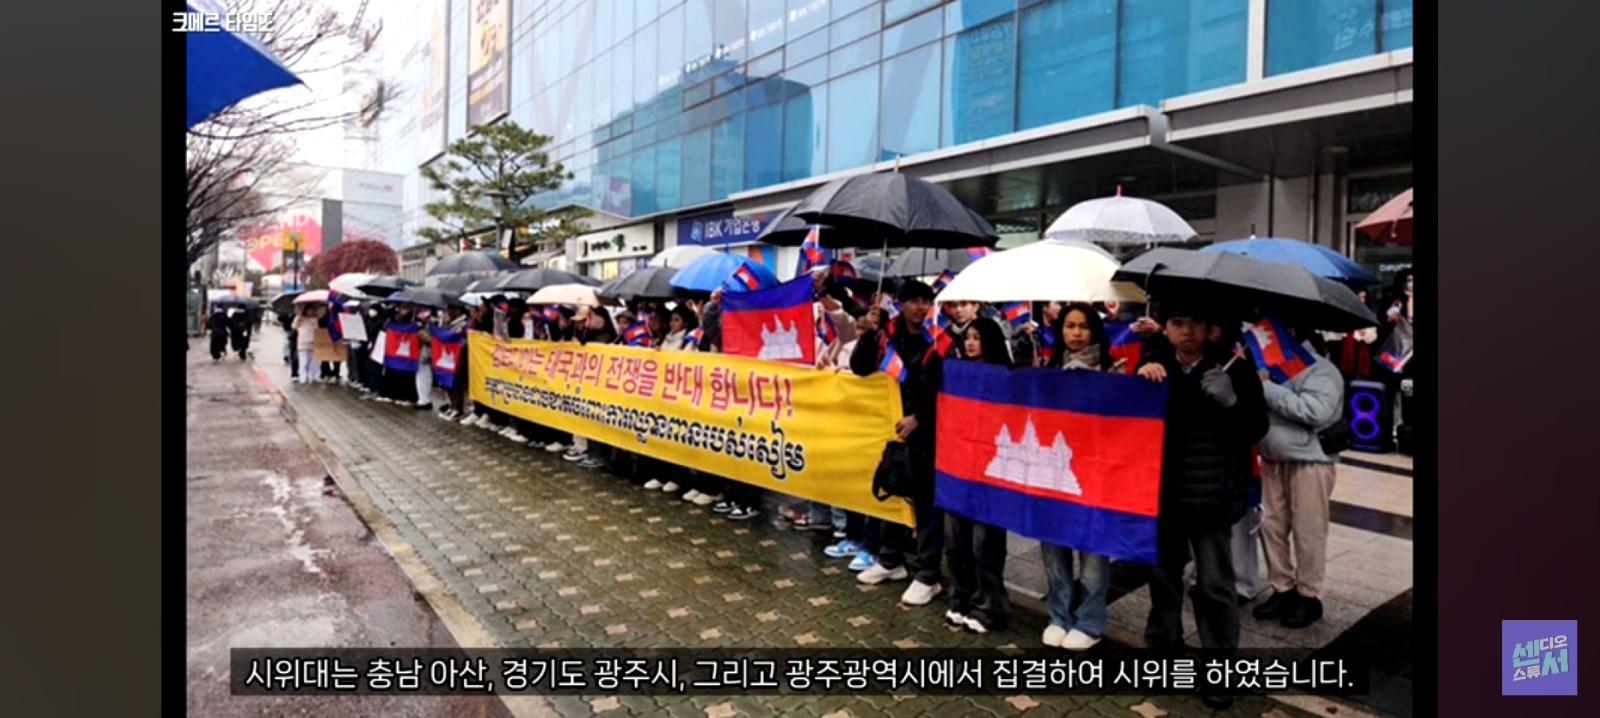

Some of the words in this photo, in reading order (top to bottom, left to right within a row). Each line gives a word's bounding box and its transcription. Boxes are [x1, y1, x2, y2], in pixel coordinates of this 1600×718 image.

[704, 220, 723, 239] IBK
[544, 348, 605, 387] 태국과의
[605, 354, 659, 397] 전쟁을
[661, 361, 703, 407] 반대
[709, 365, 793, 420] 합니다!
